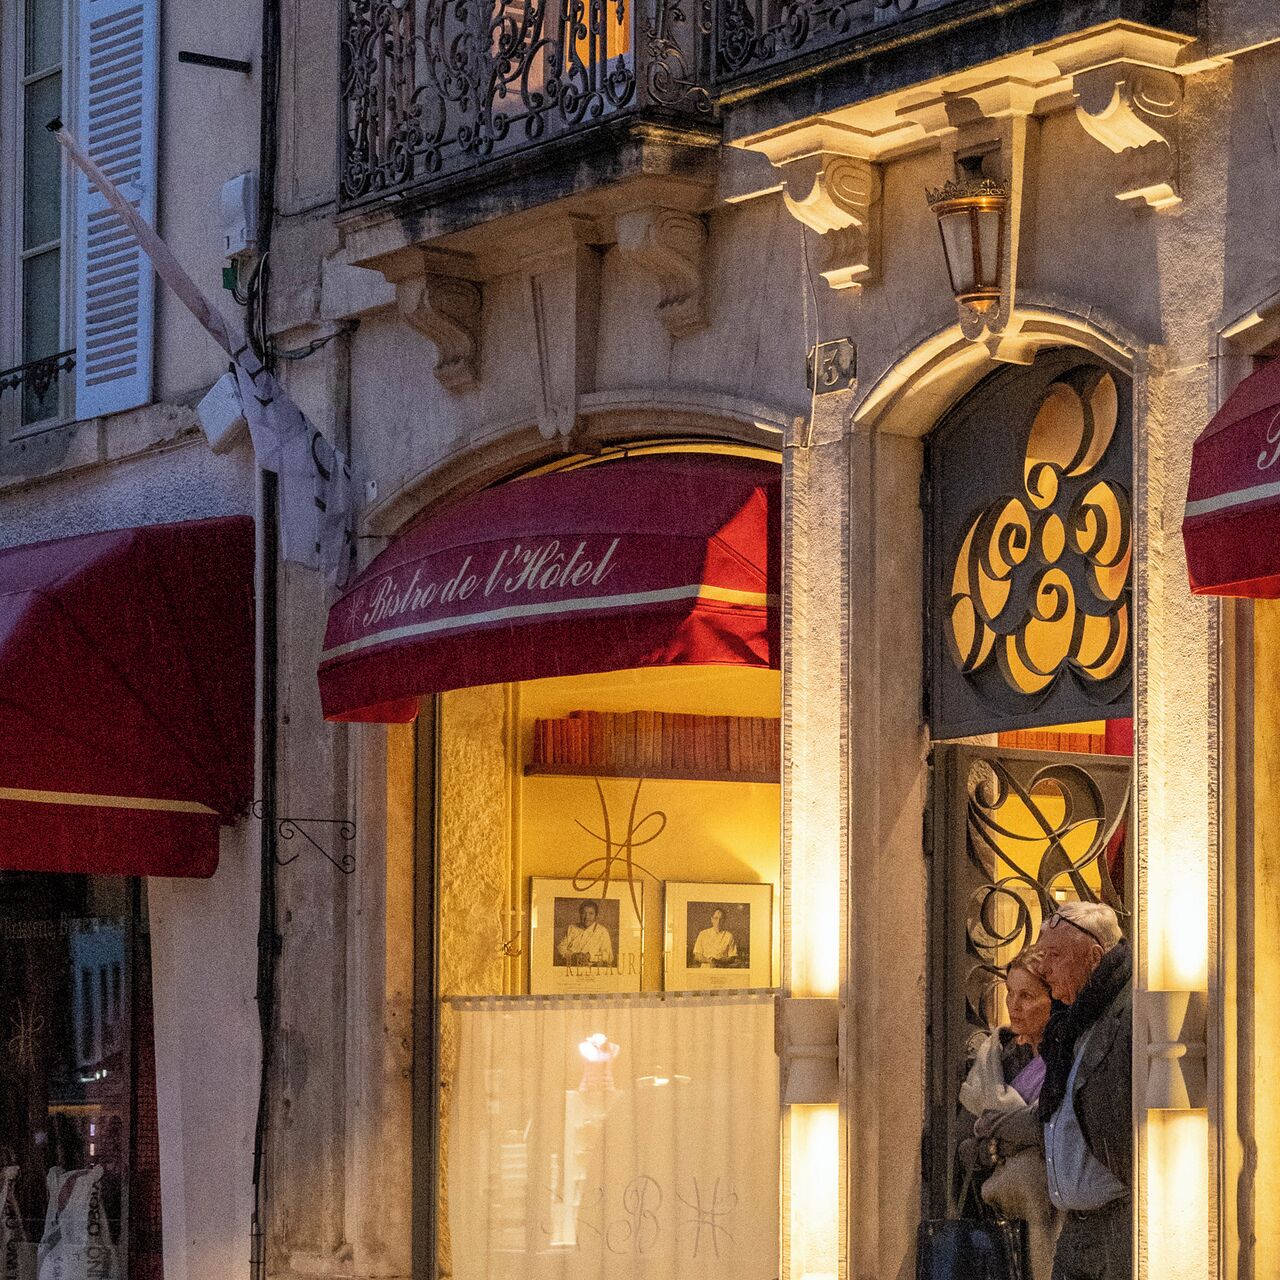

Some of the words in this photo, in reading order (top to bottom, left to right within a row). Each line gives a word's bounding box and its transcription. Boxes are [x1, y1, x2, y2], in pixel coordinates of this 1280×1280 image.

[363, 568, 440, 628] Bistro
[438, 555, 483, 603] de
[483, 537, 621, 597] l'Hôtel
